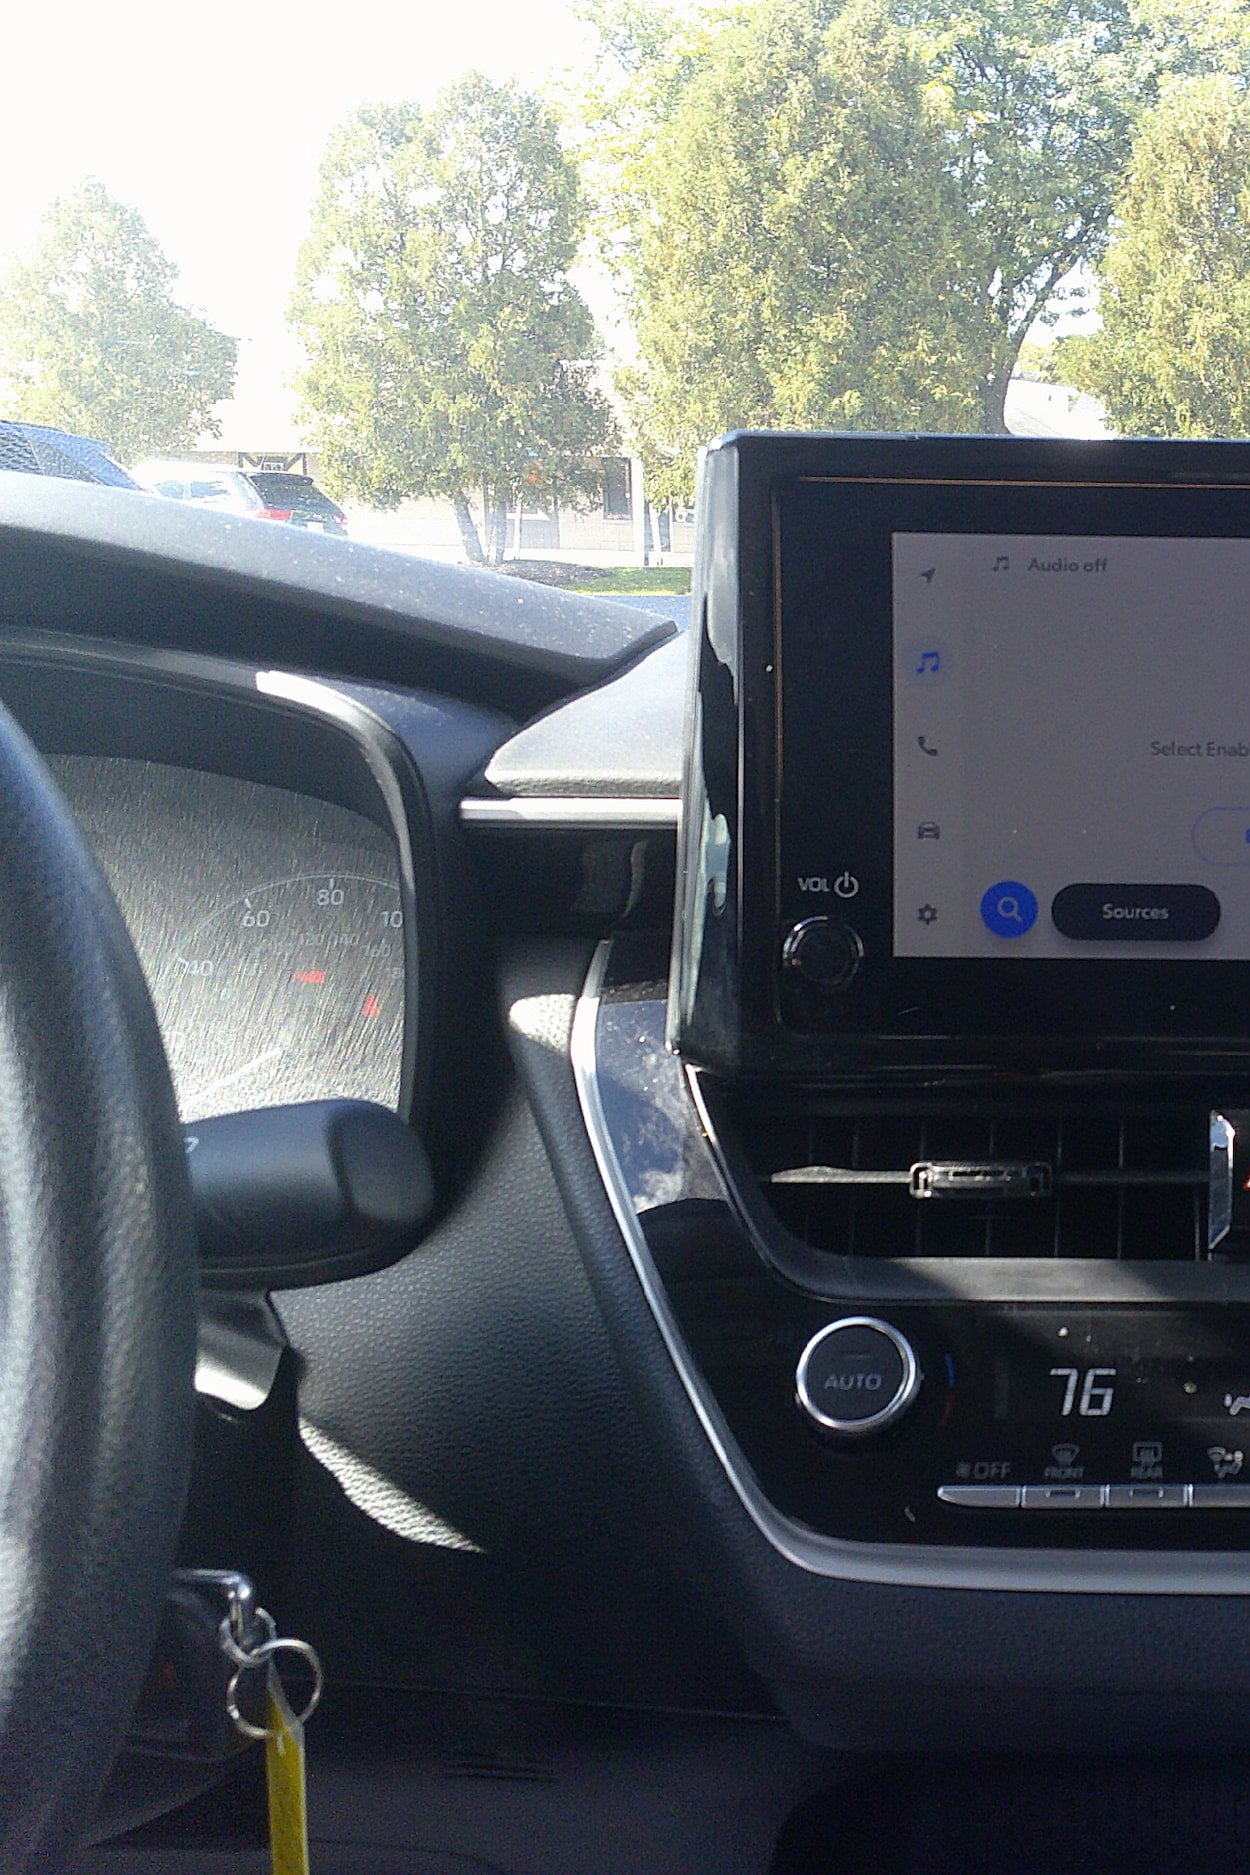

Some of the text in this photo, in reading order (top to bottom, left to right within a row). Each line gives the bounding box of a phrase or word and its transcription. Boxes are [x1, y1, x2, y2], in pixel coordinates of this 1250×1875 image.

[1028, 557, 1107, 573] Audio off
[1150, 740, 1201, 757] Select
[797, 877, 831, 893] VOL
[317, 889, 344, 906] 80
[242, 910, 270, 927] 60
[1103, 903, 1169, 920] Sources
[824, 1373, 882, 1391] AUTO
[1050, 1367, 1117, 1416] 76
[973, 1462, 1011, 1479] OFF
